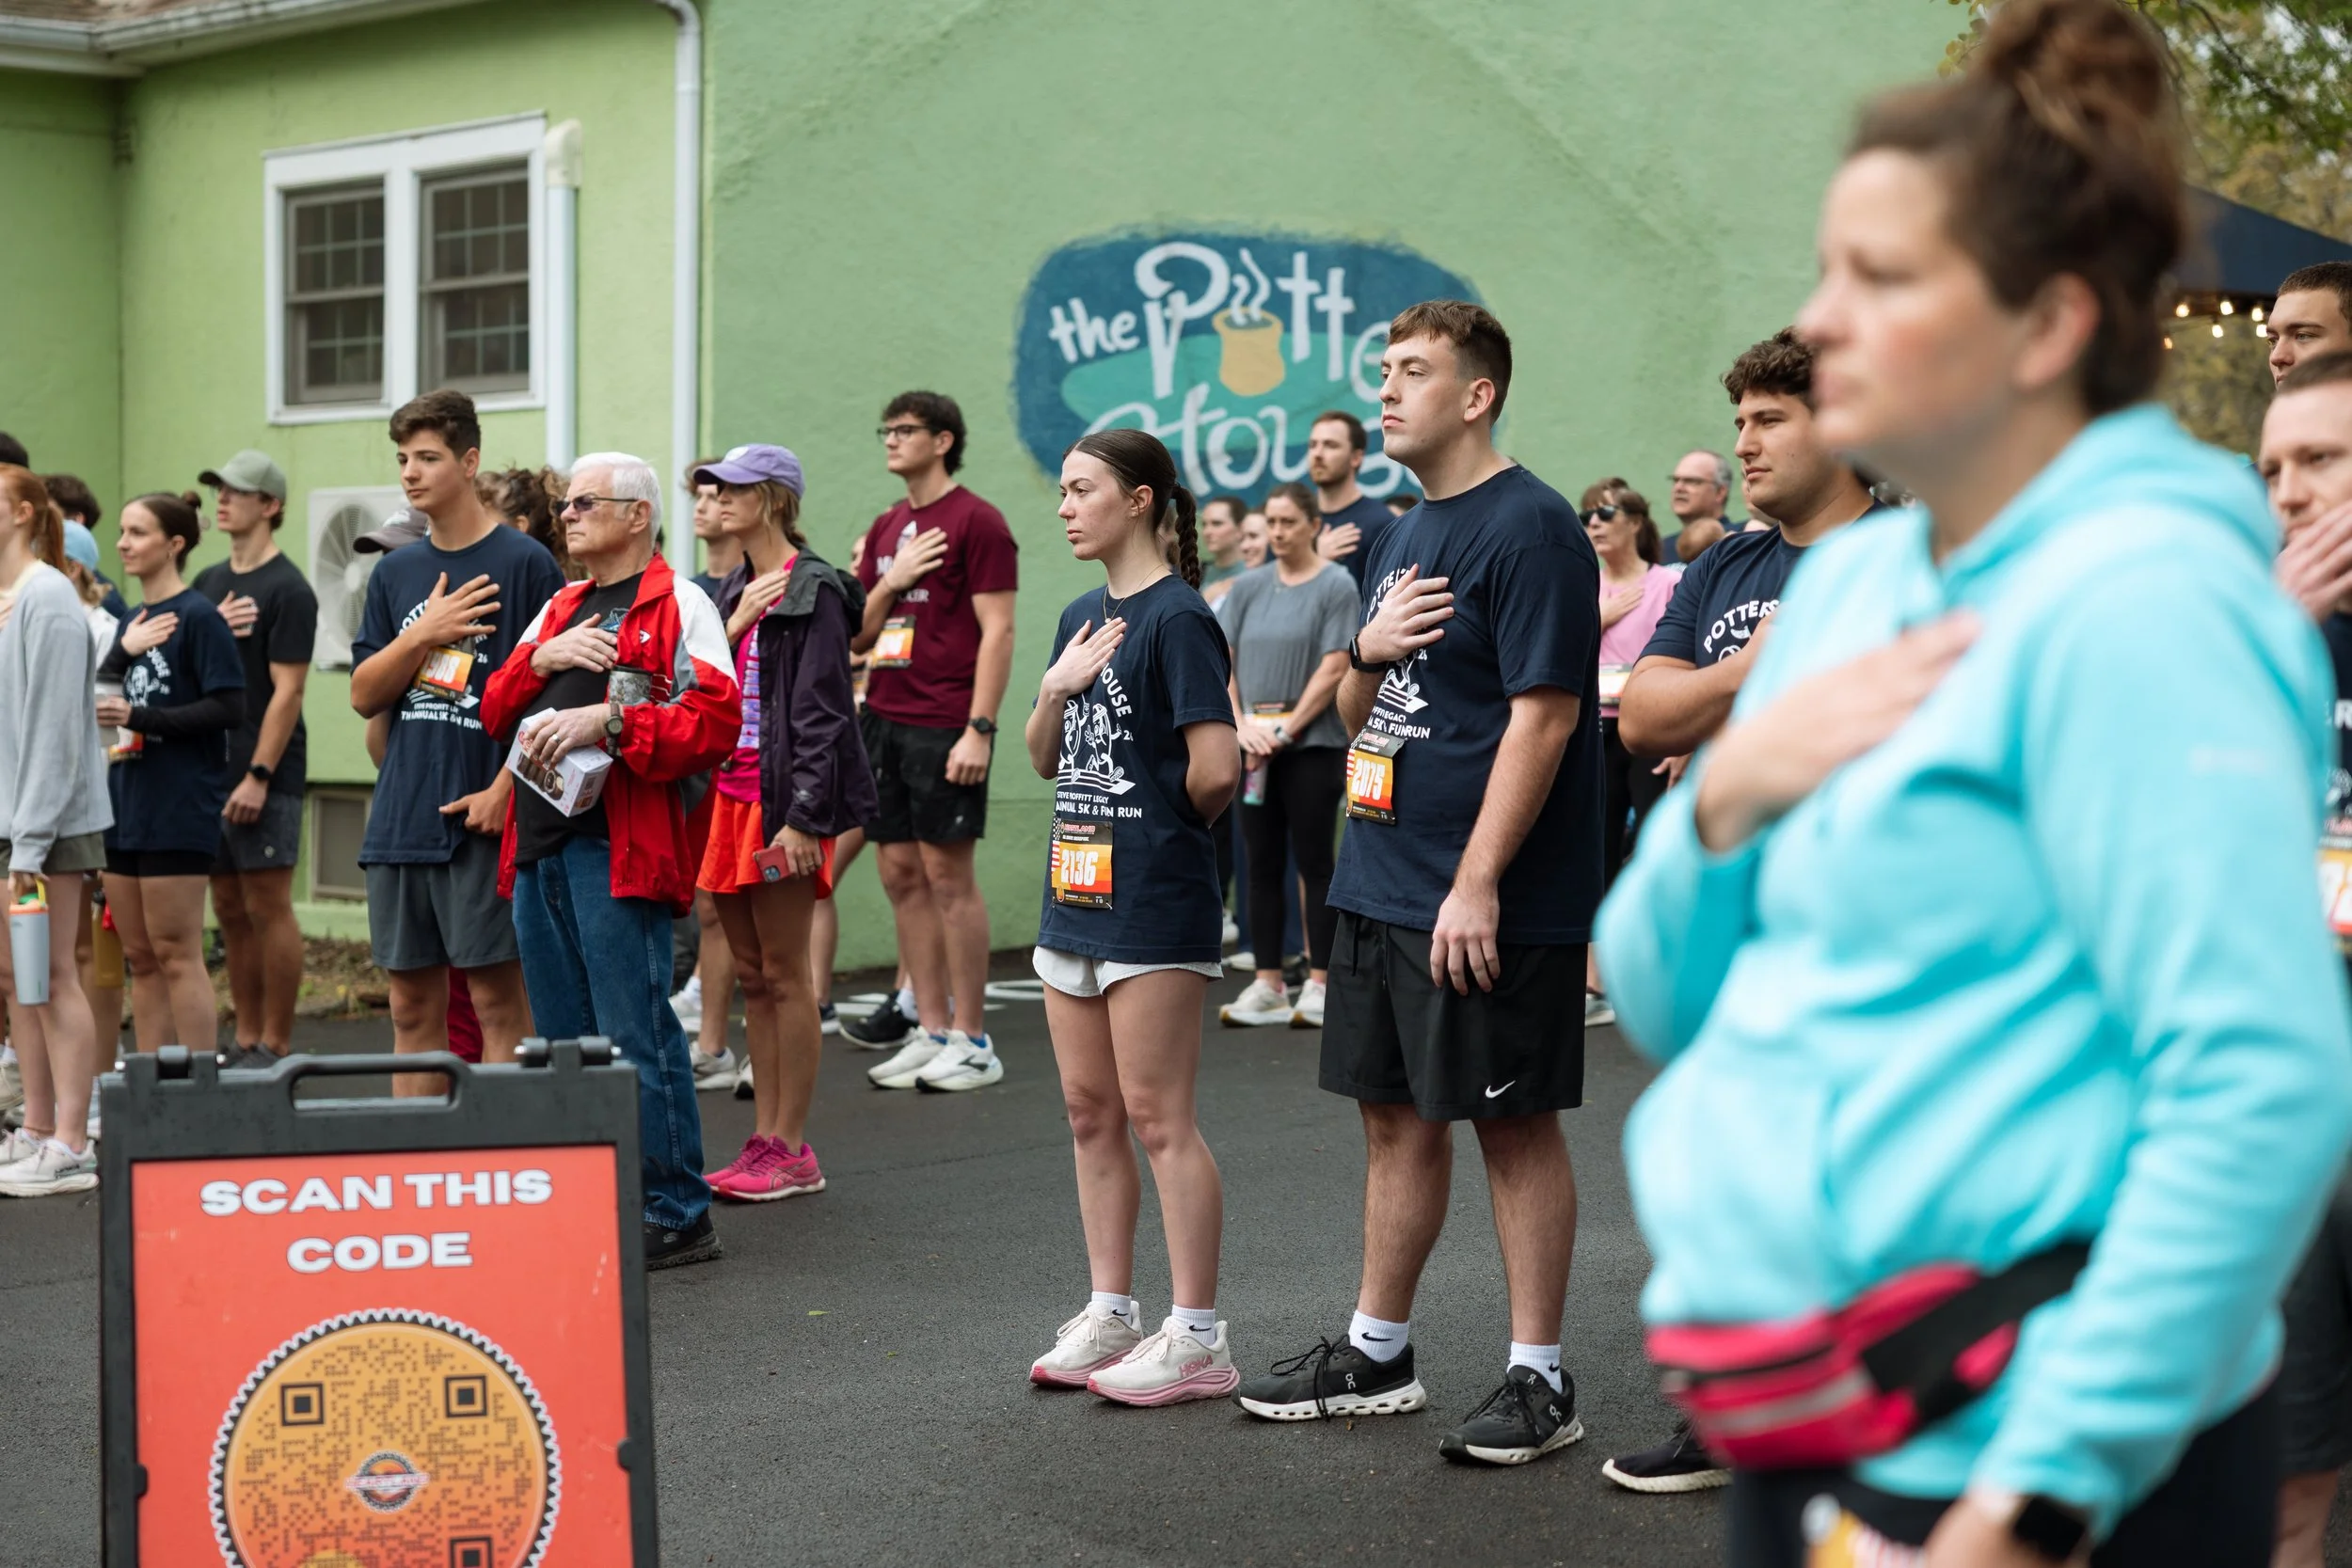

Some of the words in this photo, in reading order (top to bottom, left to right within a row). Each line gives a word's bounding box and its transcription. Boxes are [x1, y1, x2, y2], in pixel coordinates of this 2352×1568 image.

[1048, 297, 1140, 363] the
[1384, 710, 1406, 723] EGACY
[1403, 724, 1431, 739] RUN
[1351, 758, 1385, 800] 2075
[1077, 802, 1091, 815] 5K
[1091, 805, 1099, 816] &
[1117, 806, 1142, 818] RUN
[1060, 849, 1099, 887] 2136
[199, 1175, 392, 1216] SCAN
[403, 1169, 553, 1208] THIS
[287, 1232, 473, 1274] CODE
[1180, 1354, 1214, 1377] HOKA
